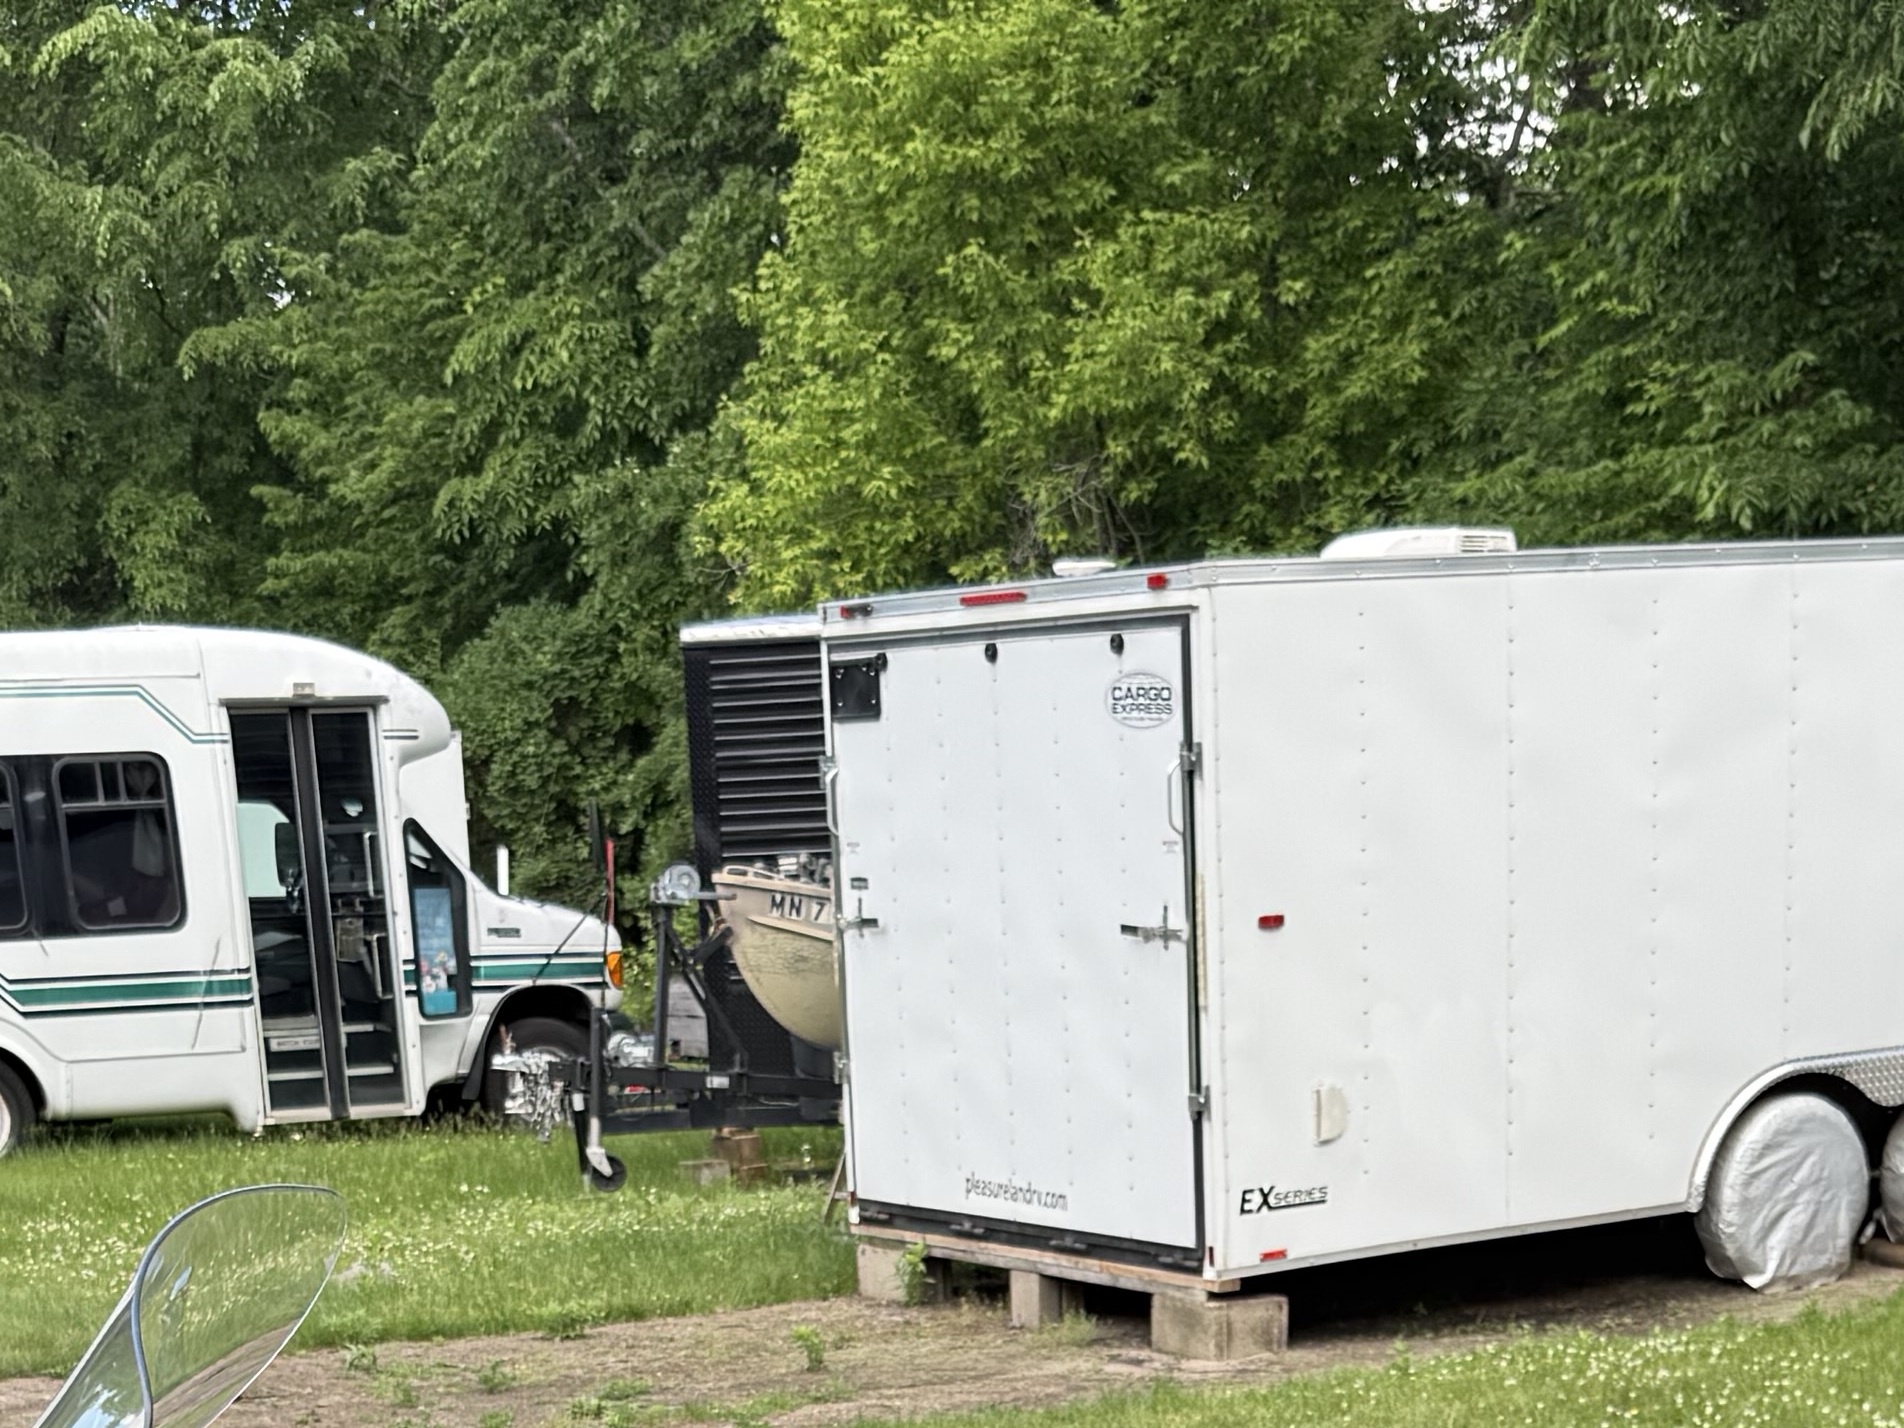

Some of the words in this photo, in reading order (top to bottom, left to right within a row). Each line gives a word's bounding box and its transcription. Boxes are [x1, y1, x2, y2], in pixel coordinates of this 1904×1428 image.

[1111, 686, 1172, 702] CARGO
[1111, 702, 1173, 715] EXPRESS
[770, 894, 802, 918] MN
